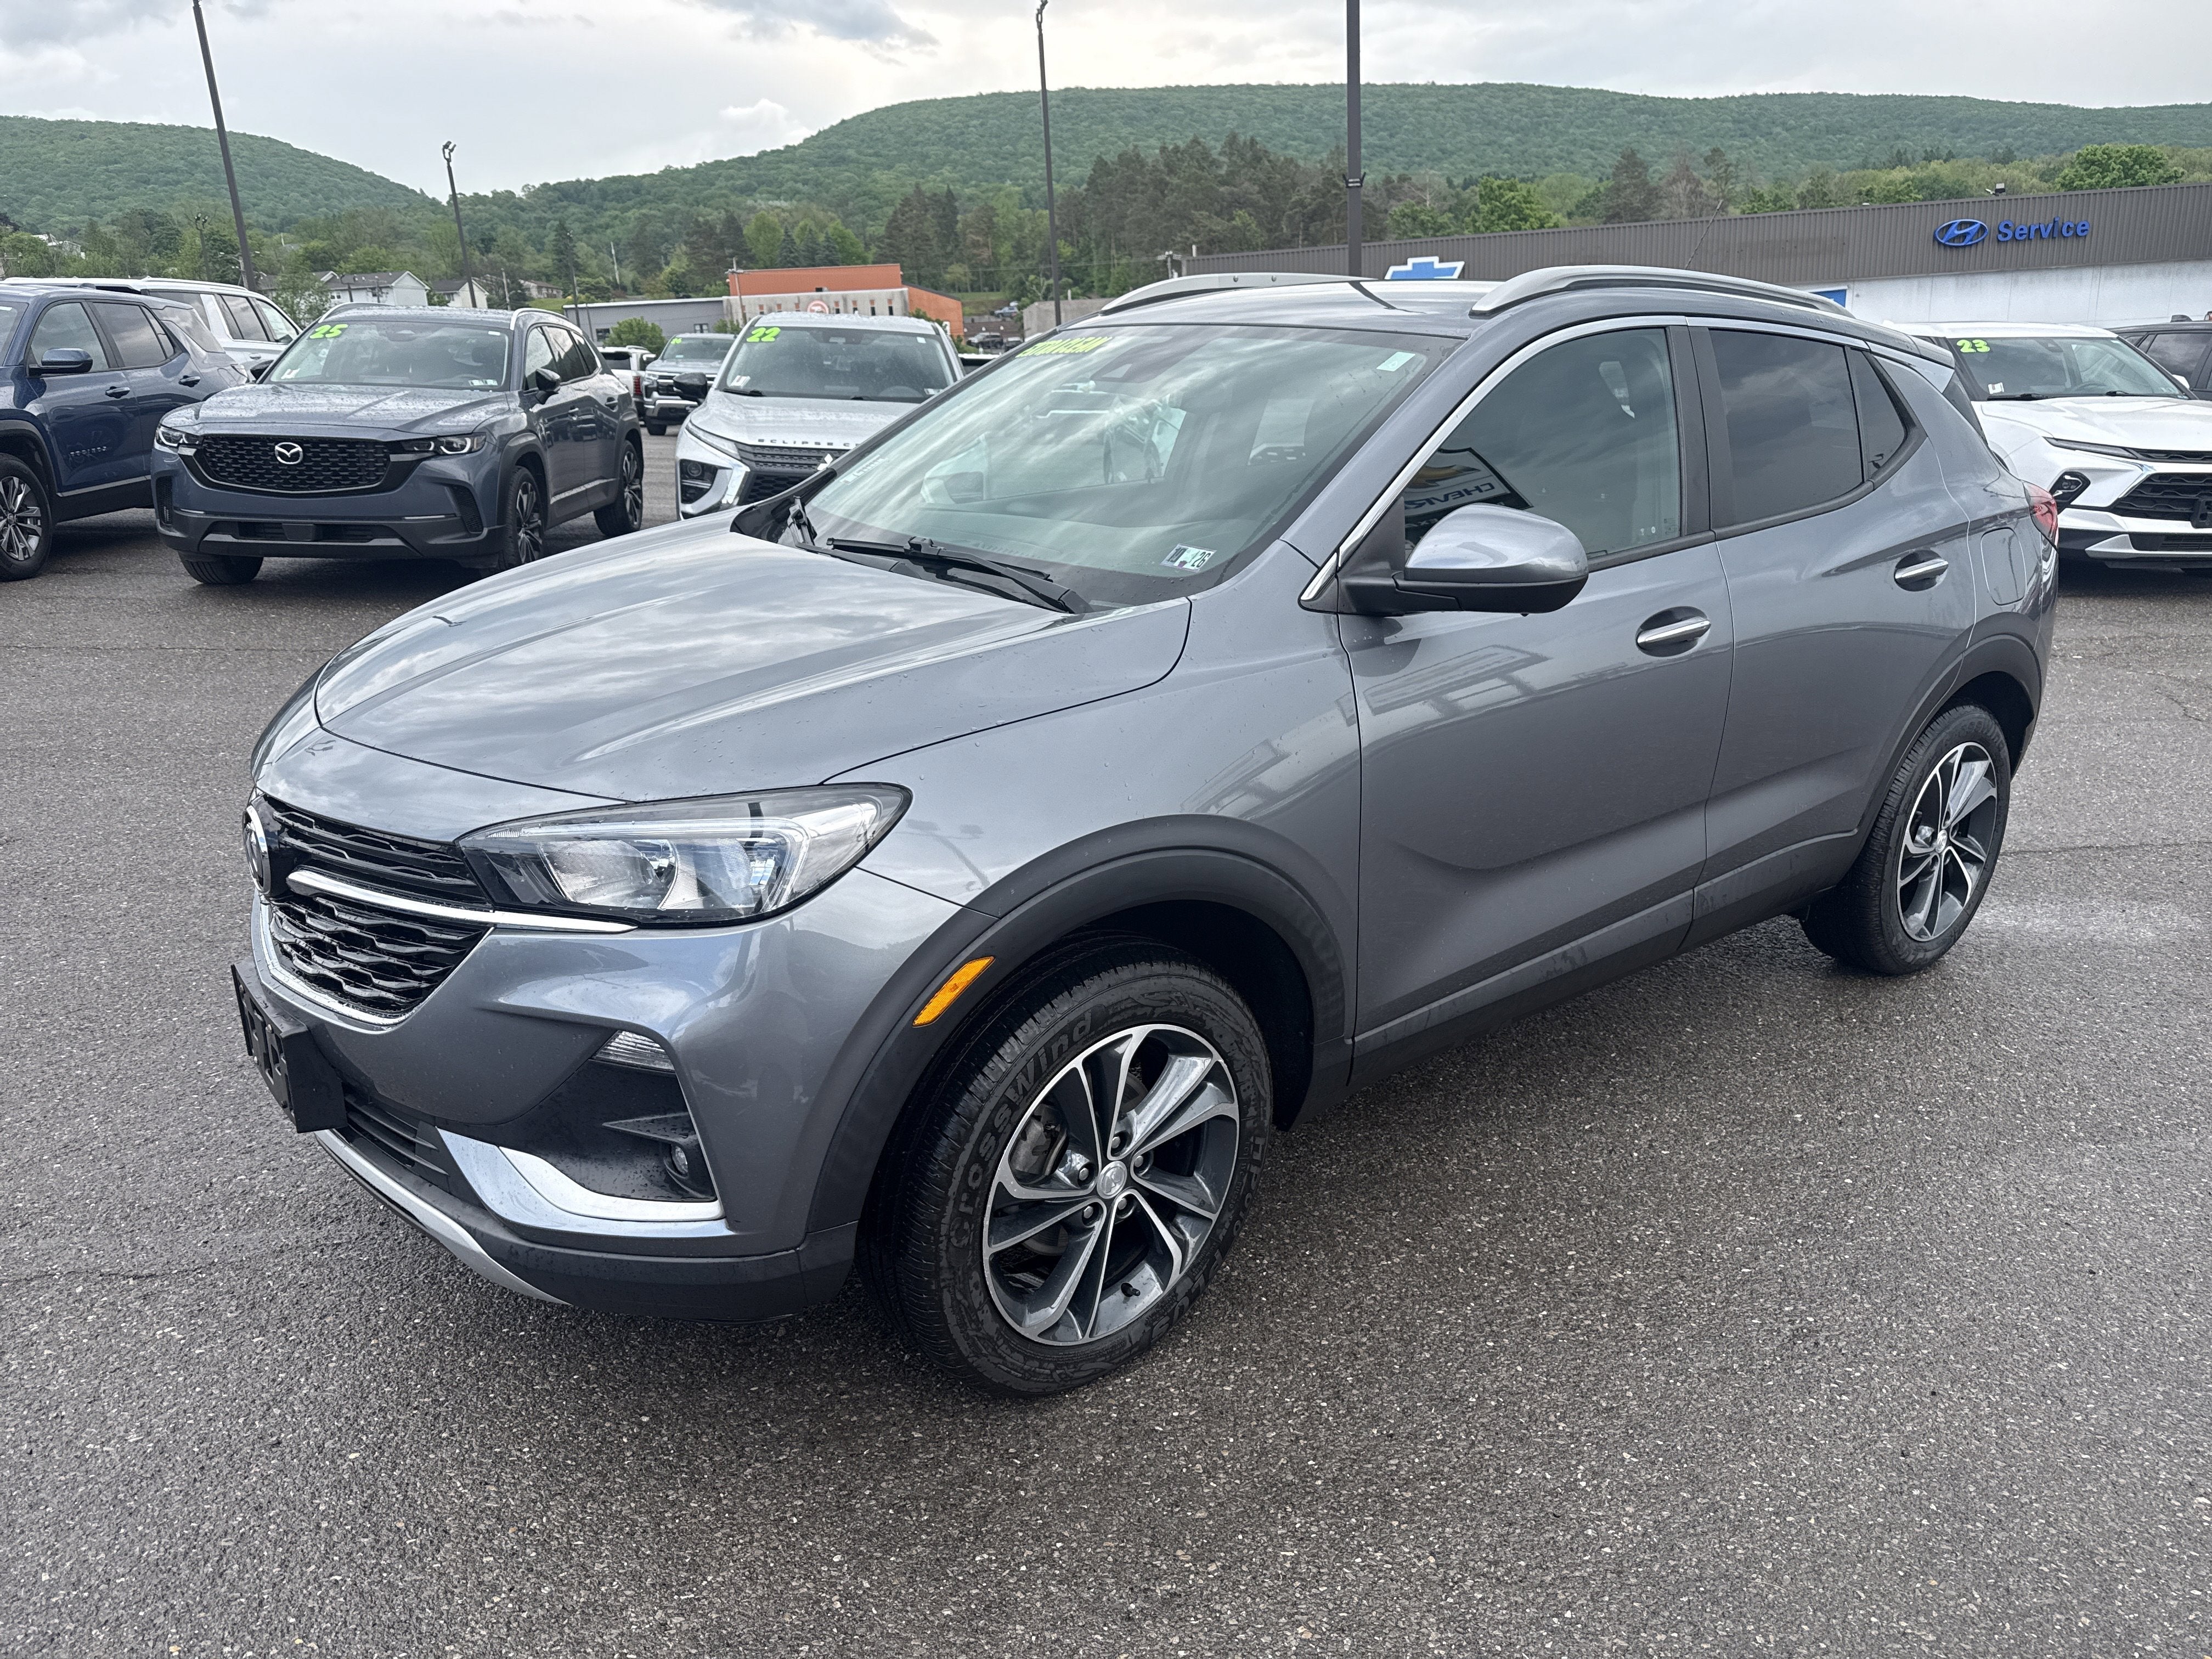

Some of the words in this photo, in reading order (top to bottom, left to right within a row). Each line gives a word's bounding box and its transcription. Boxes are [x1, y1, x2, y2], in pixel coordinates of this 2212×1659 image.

[1997, 217, 2090, 241] Service
[309, 324, 348, 338] 25
[747, 327, 781, 342] 22
[1956, 340, 1990, 352] 23
[1190, 552, 1211, 568] 26
[950, 1012, 1092, 1249] CrossWind
